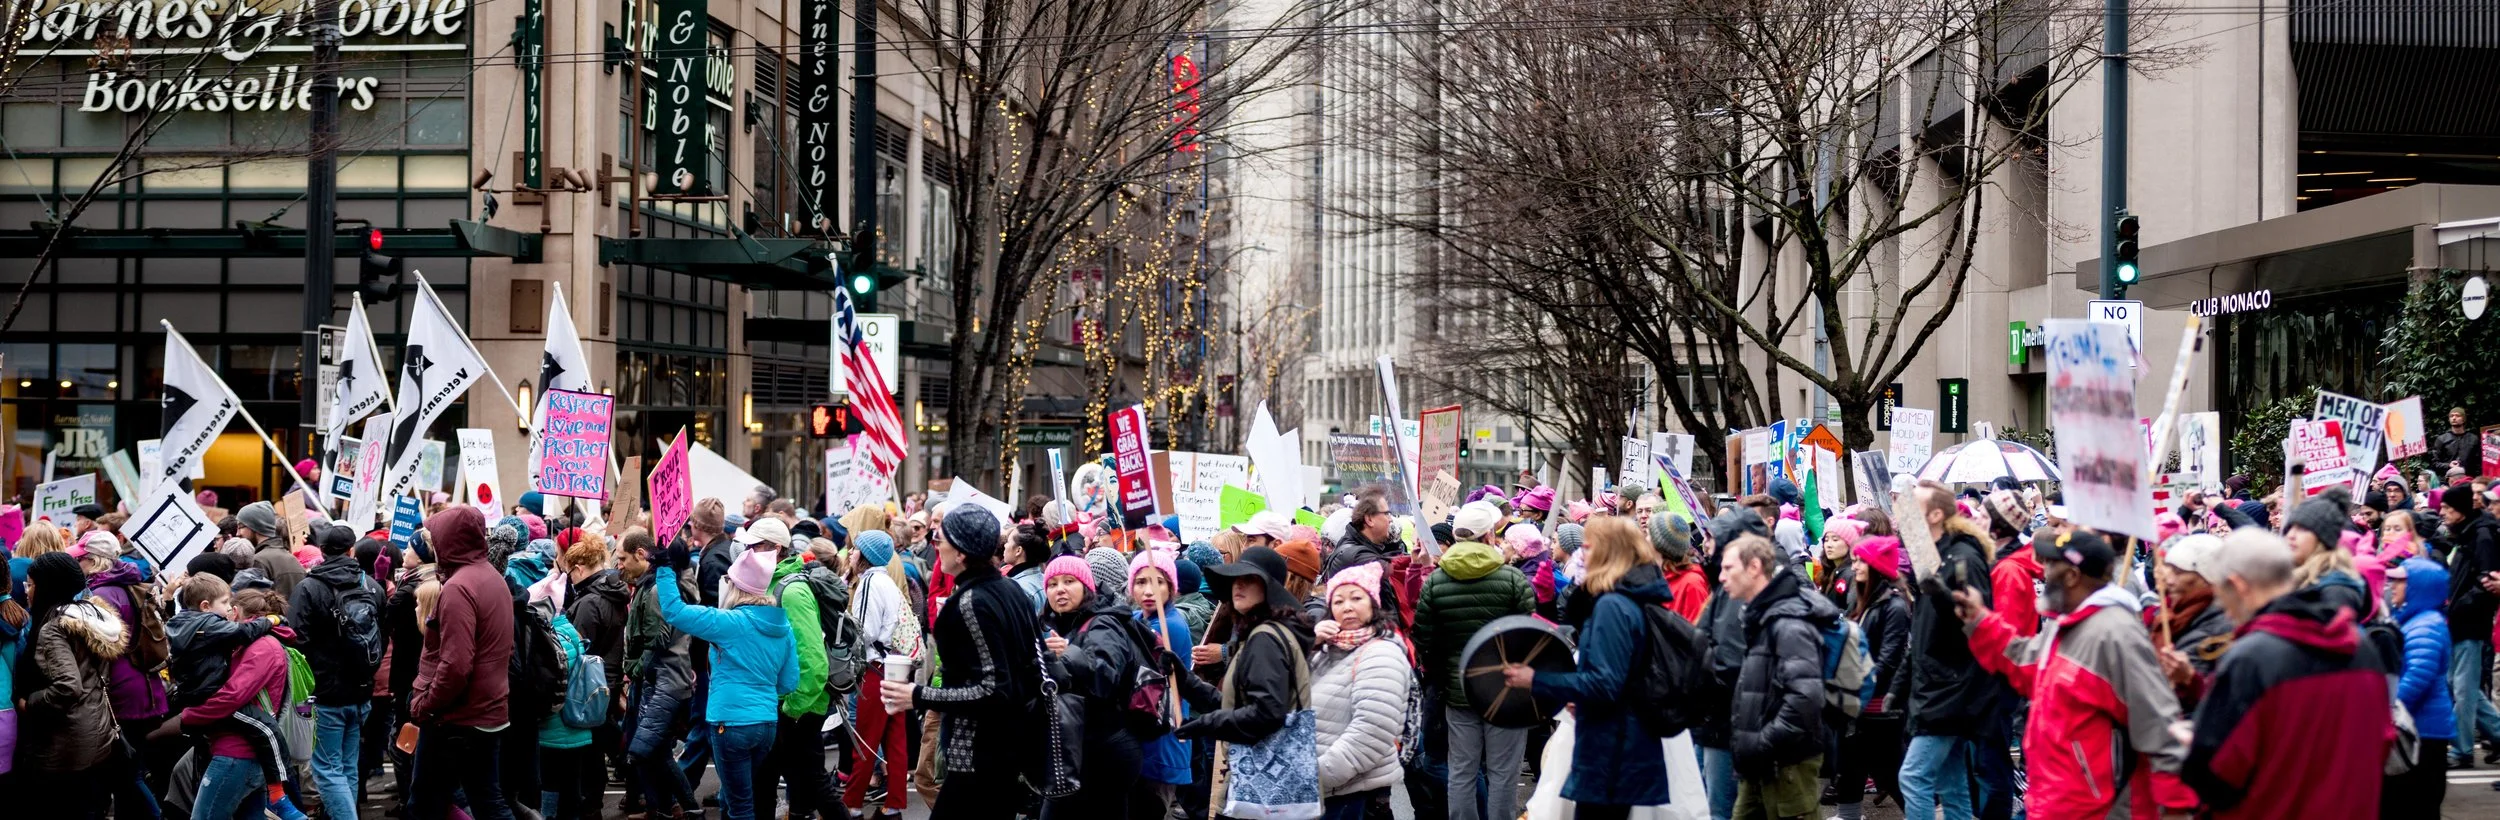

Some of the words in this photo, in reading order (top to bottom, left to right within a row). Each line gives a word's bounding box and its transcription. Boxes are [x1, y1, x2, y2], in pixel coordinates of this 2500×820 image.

[1, 0, 218, 41] Barnes
[217, 0, 284, 61] &
[669, 10, 695, 44] &
[812, 3, 827, 76] rnes
[706, 45, 734, 97] oble
[808, 84, 829, 113] &
[667, 57, 695, 187] Noble
[807, 122, 830, 229] Noble
[2104, 307, 2127, 319] NO
[2190, 297, 2218, 317] CLUB
[2221, 289, 2271, 314] MONACO
[865, 342, 883, 352] RN
[836, 409, 846, 430] 4
[1892, 411, 1931, 426] WOMEN
[2320, 395, 2359, 420] MEN
[2361, 405, 2383, 426] OF
[586, 421, 606, 433] and
[1117, 415, 1131, 433] WE
[2297, 423, 2327, 444] END
[1117, 434, 1138, 454] GRAB
[1892, 429, 1914, 439] HOLD
[1917, 431, 1929, 440] UP
[2298, 436, 2337, 452] RACISM
[1890, 443, 1908, 453] HALF
[1913, 444, 1929, 455] THE
[2300, 446, 2340, 461] SEXISM
[653, 449, 680, 495] PROUD
[1119, 453, 1144, 473] BACK!
[1898, 456, 1920, 469] SKY
[43, 496, 67, 511] Free
[660, 488, 682, 520] REAL
[1234, 499, 1256, 515] NO
[391, 533, 411, 542] EQUALIT
